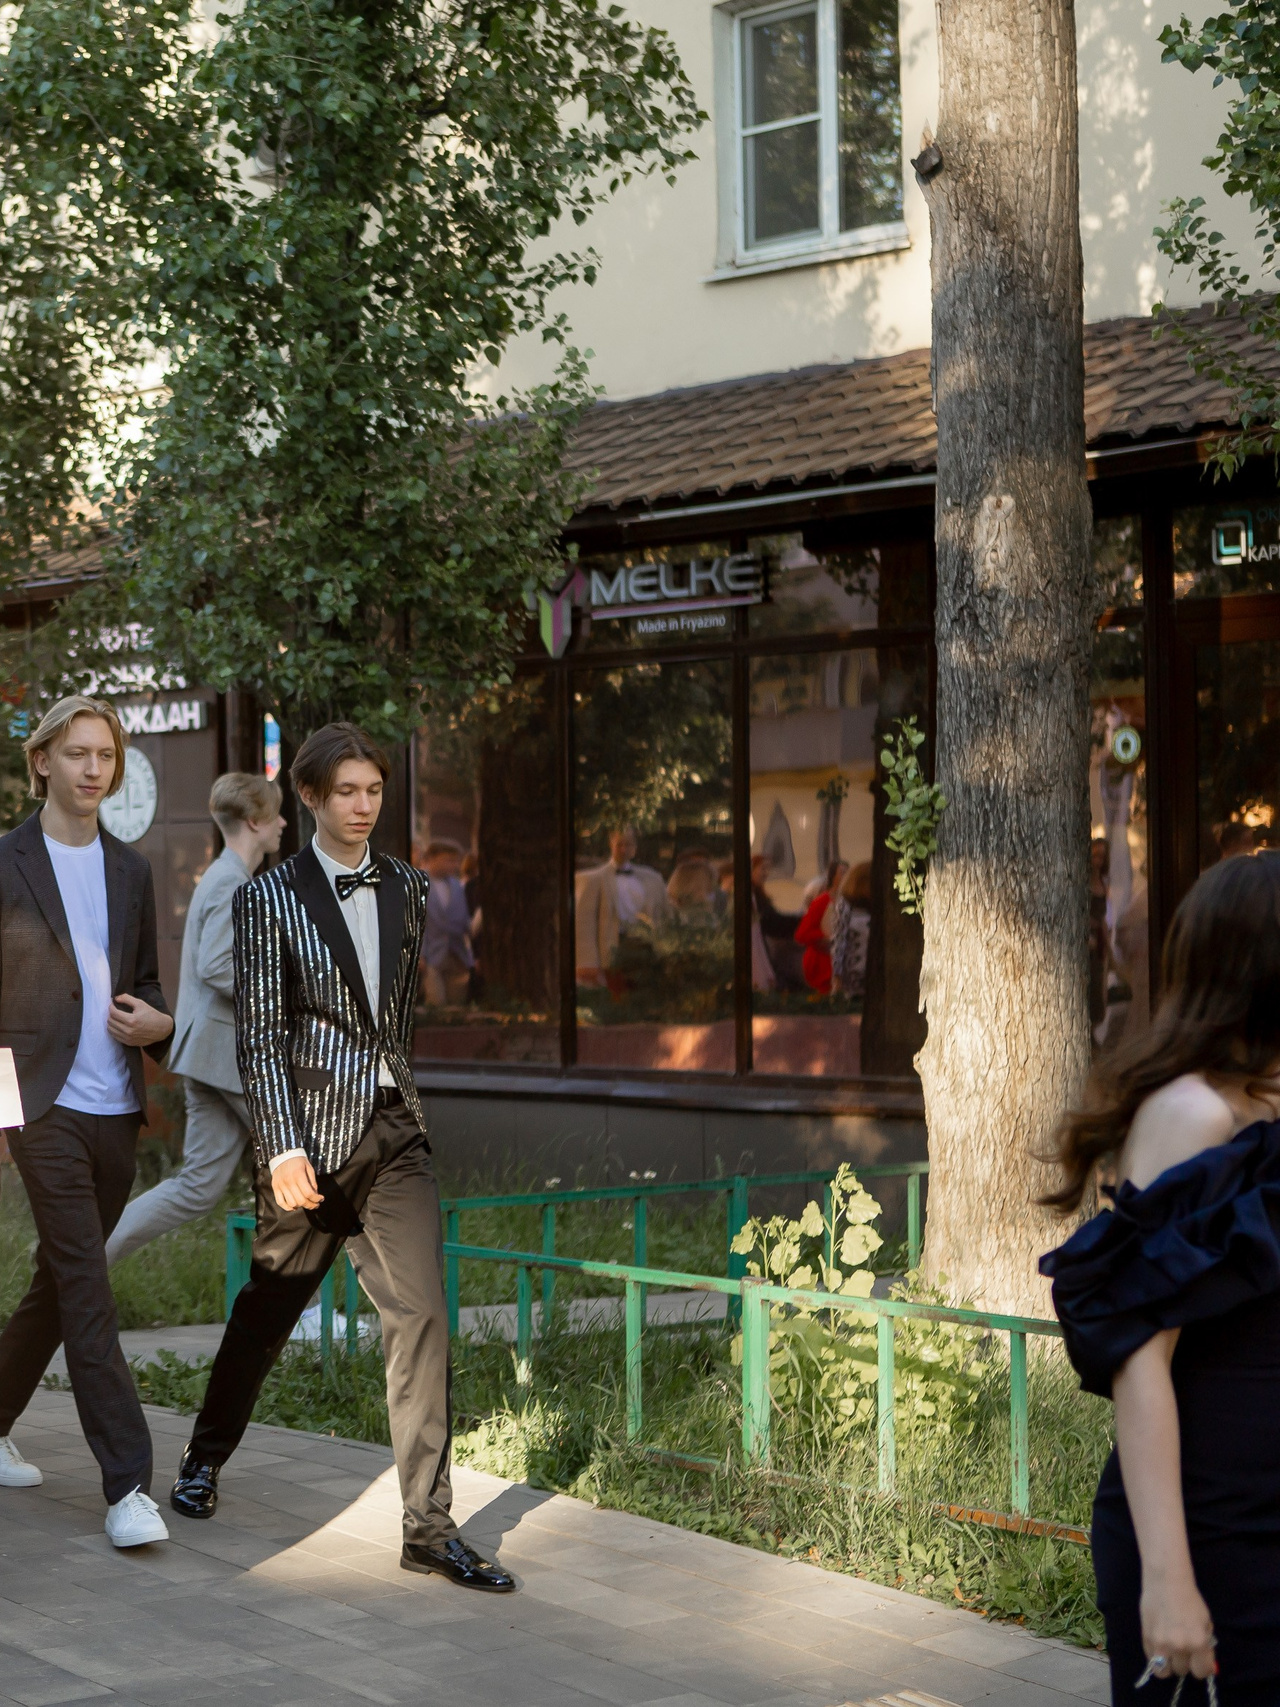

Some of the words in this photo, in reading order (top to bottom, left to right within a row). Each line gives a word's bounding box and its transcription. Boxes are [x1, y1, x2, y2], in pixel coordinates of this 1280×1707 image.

[590, 554, 756, 606] MELKE
[637, 619, 667, 634] Made
[669, 617, 679, 631] in
